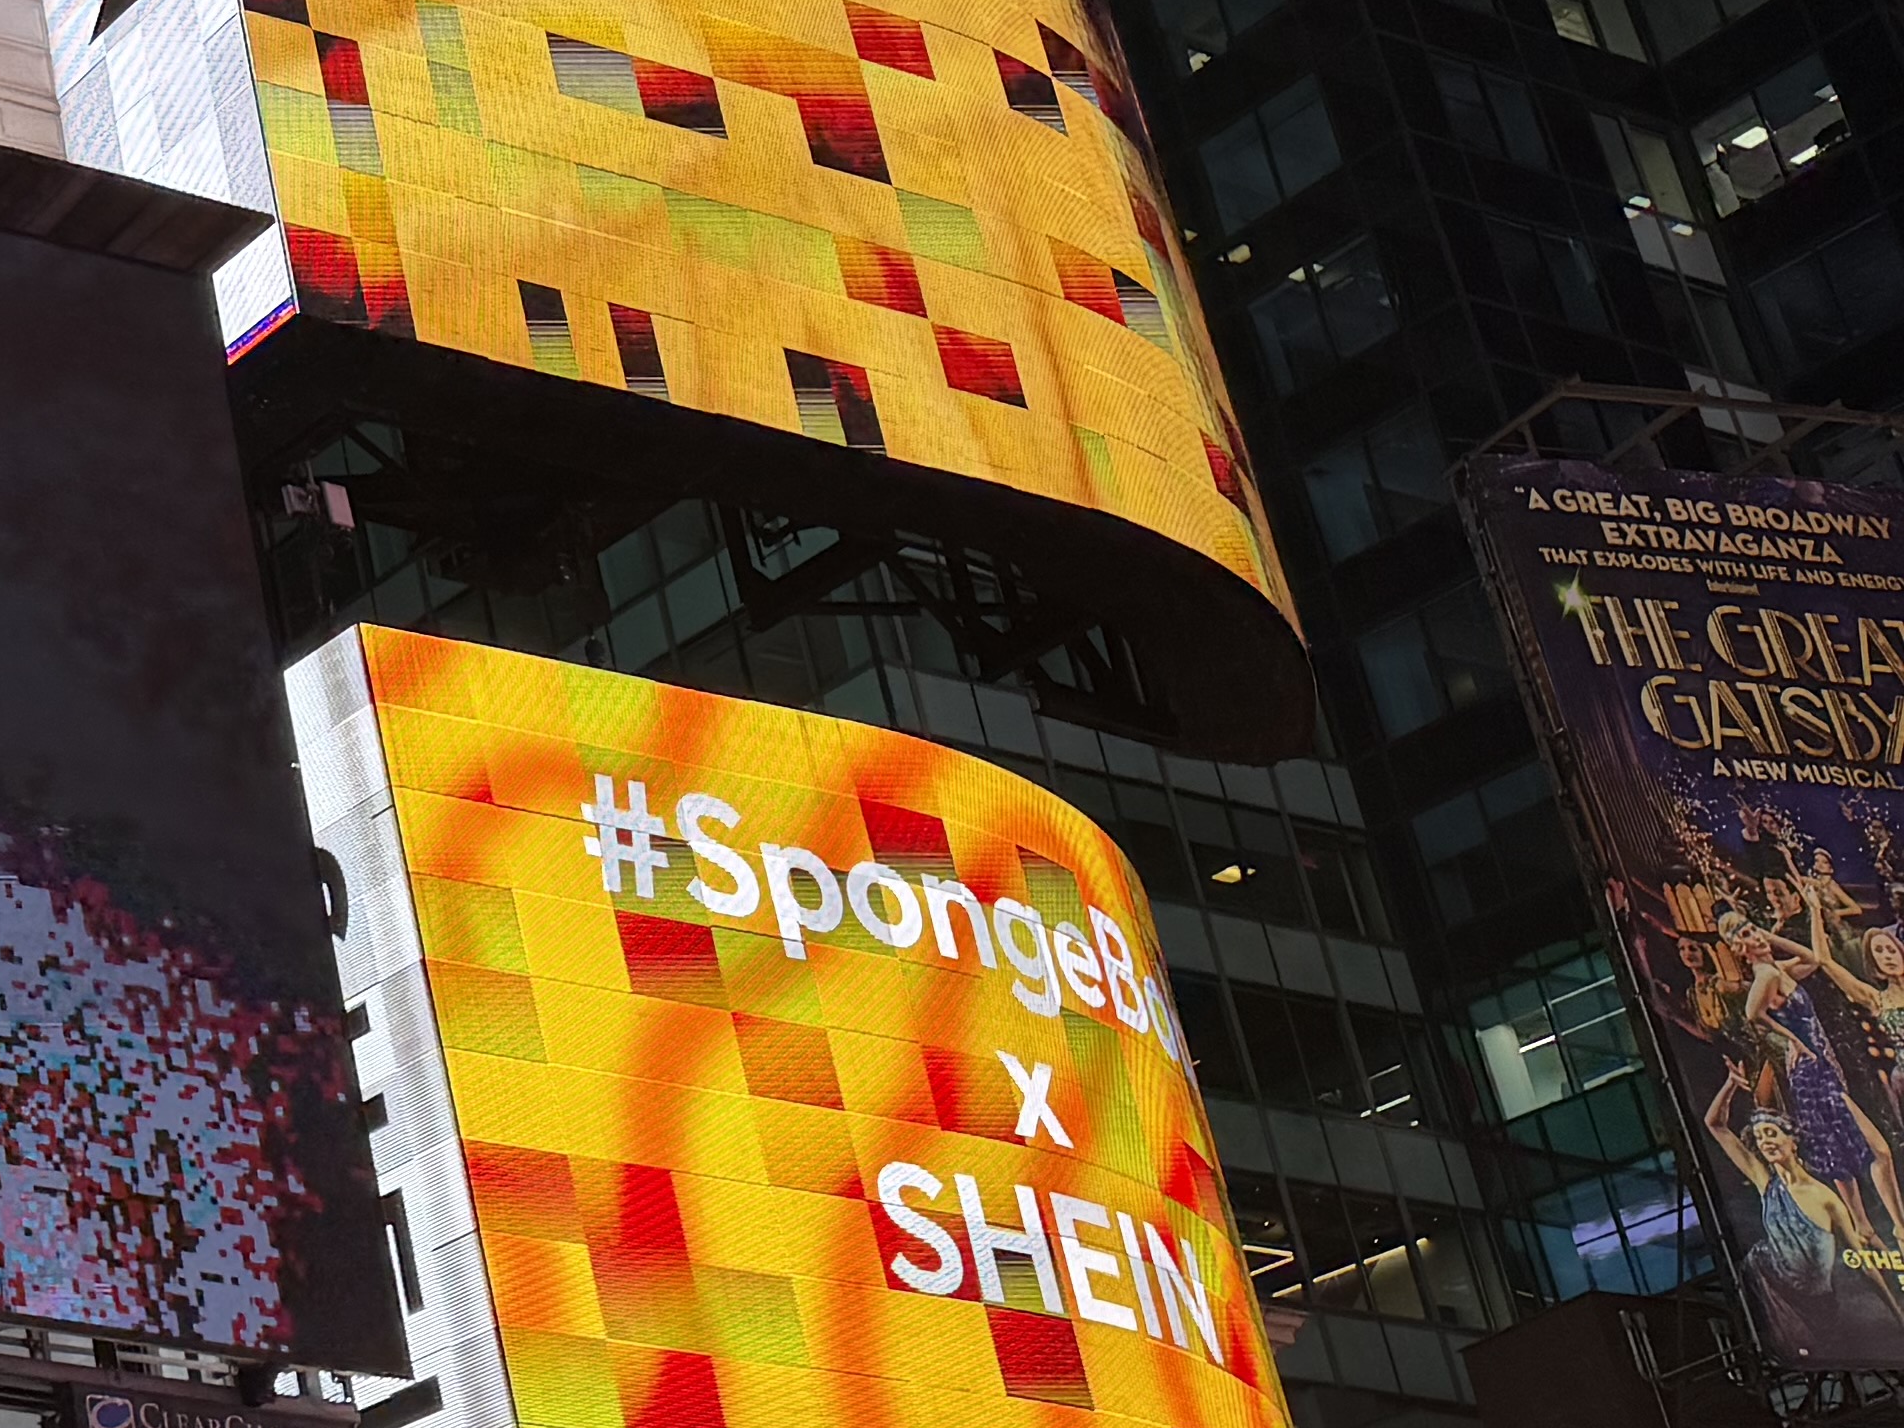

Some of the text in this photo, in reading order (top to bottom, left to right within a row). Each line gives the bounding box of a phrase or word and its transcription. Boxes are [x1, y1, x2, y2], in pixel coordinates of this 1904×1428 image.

[1553, 486, 1662, 525] GREAT,
[1667, 495, 1721, 528] BIG
[1725, 500, 1892, 543] BROADWAY
[1539, 545, 1588, 568] THAT
[1592, 548, 1694, 575] EXPLODES
[1697, 557, 1747, 579] WITH
[1750, 564, 1792, 582] LIFE
[1796, 568, 1835, 587] AND
[1602, 520, 1844, 565] EXTRAVAGANZA
[1574, 595, 1703, 673] THE
[1712, 757, 1904, 792] A NEW MUSICAL
[876, 1160, 1222, 1367] SHEIN
